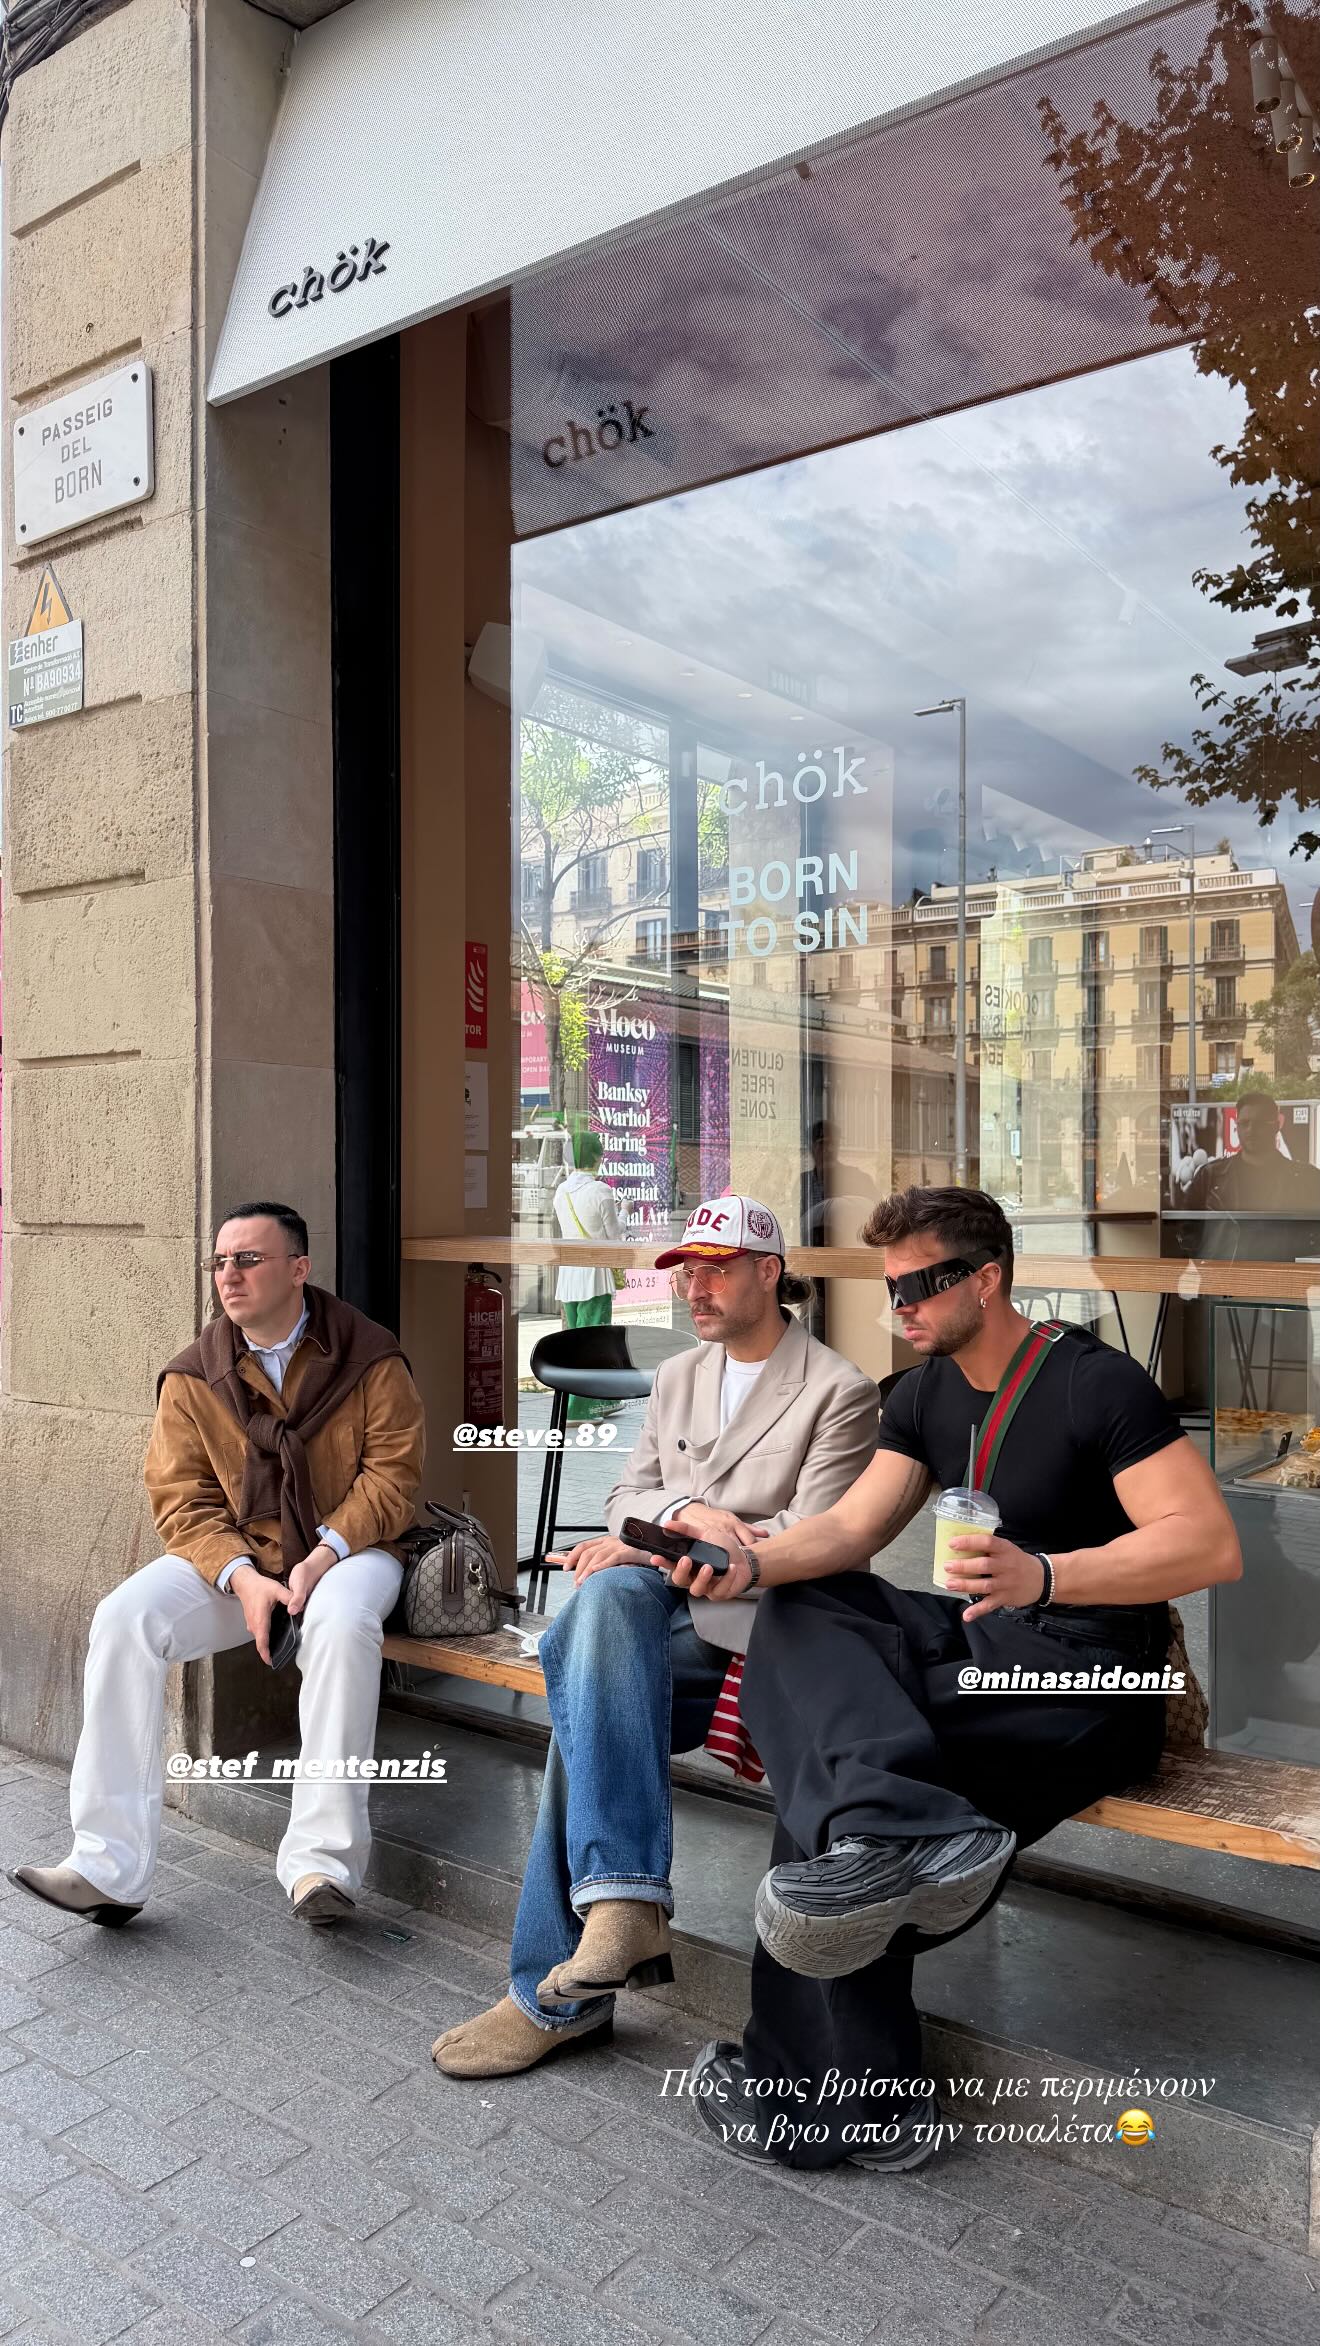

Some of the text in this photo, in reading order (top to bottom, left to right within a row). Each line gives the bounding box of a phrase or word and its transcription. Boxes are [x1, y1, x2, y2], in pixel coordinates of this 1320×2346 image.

[267, 236, 391, 319] chök
[41, 398, 113, 447] PASSEIG
[543, 400, 655, 468] chök
[61, 436, 92, 464] DEL
[54, 459, 102, 504] BORN
[36, 661, 81, 692] BA90934
[10, 704, 23, 724] TC
[718, 746, 869, 817] chök
[729, 850, 859, 907] BORN
[718, 903, 869, 960] TO SIN
[594, 1008, 656, 1041] Moco
[605, 1043, 645, 1056] MUSEUM
[597, 1081, 651, 1108] Banksy
[597, 1106, 651, 1128] Warhol
[597, 1158, 655, 1177] Kusama
[610, 1181, 660, 1201] squiat
[647, 1206, 669, 1226] Art
[645, 1276, 656, 1288] 25
